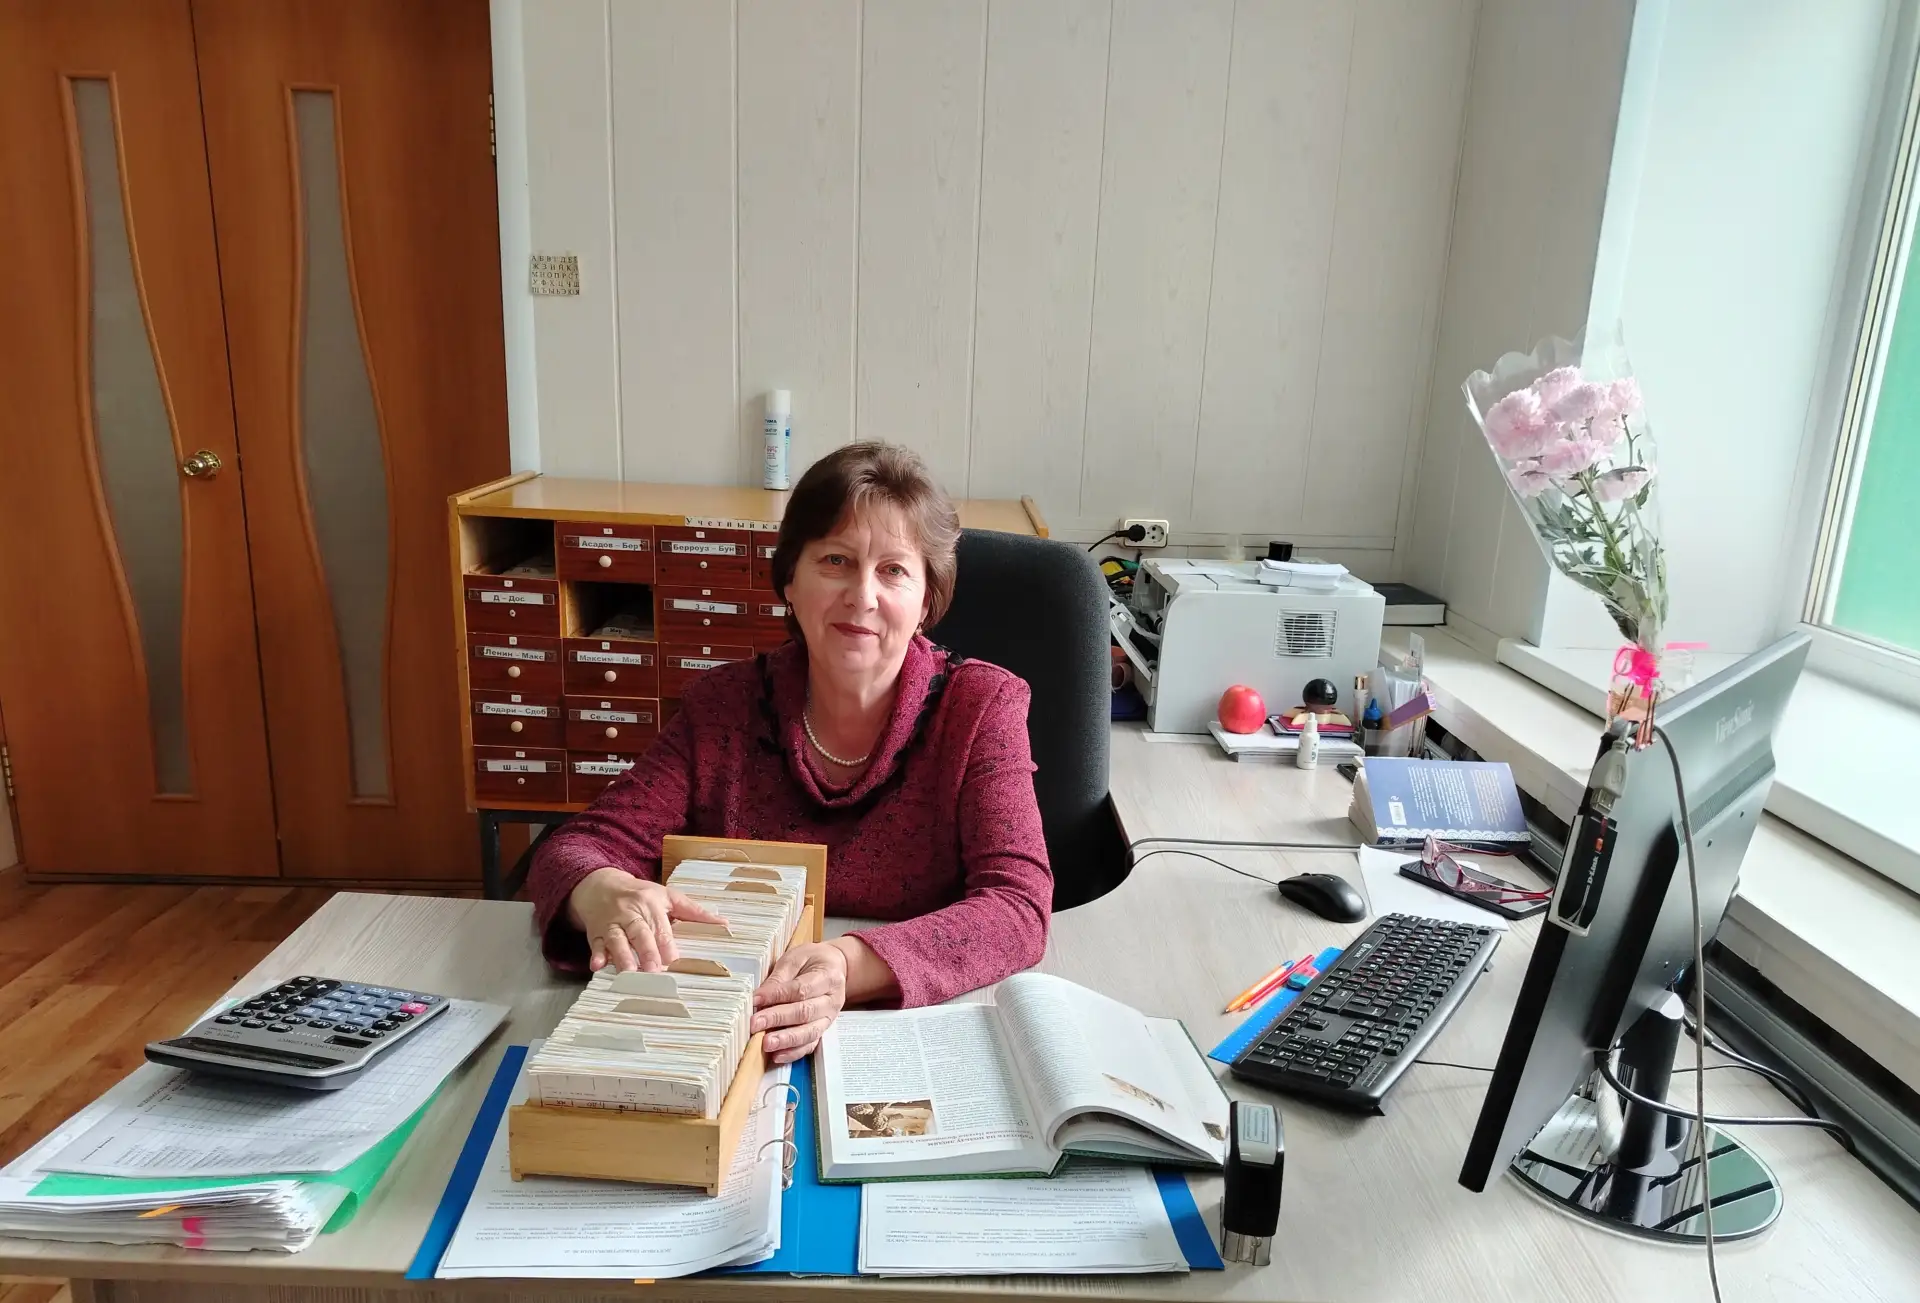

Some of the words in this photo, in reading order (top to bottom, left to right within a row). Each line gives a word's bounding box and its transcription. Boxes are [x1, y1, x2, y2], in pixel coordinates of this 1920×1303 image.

[686, 518, 755, 529] Учетный
[581, 540, 614, 550] Асадов
[673, 544, 710, 554] Берроуз
[718, 545, 734, 554] Бун
[508, 595, 525, 603] Дос
[484, 648, 513, 657] Ленин
[521, 652, 544, 660] Макс
[622, 656, 640, 664] Мих
[485, 705, 516, 714] Родари
[525, 707, 546, 716] Сдоб
[610, 714, 626, 722] Сов
[1586, 855, 1599, 886] D-Link
